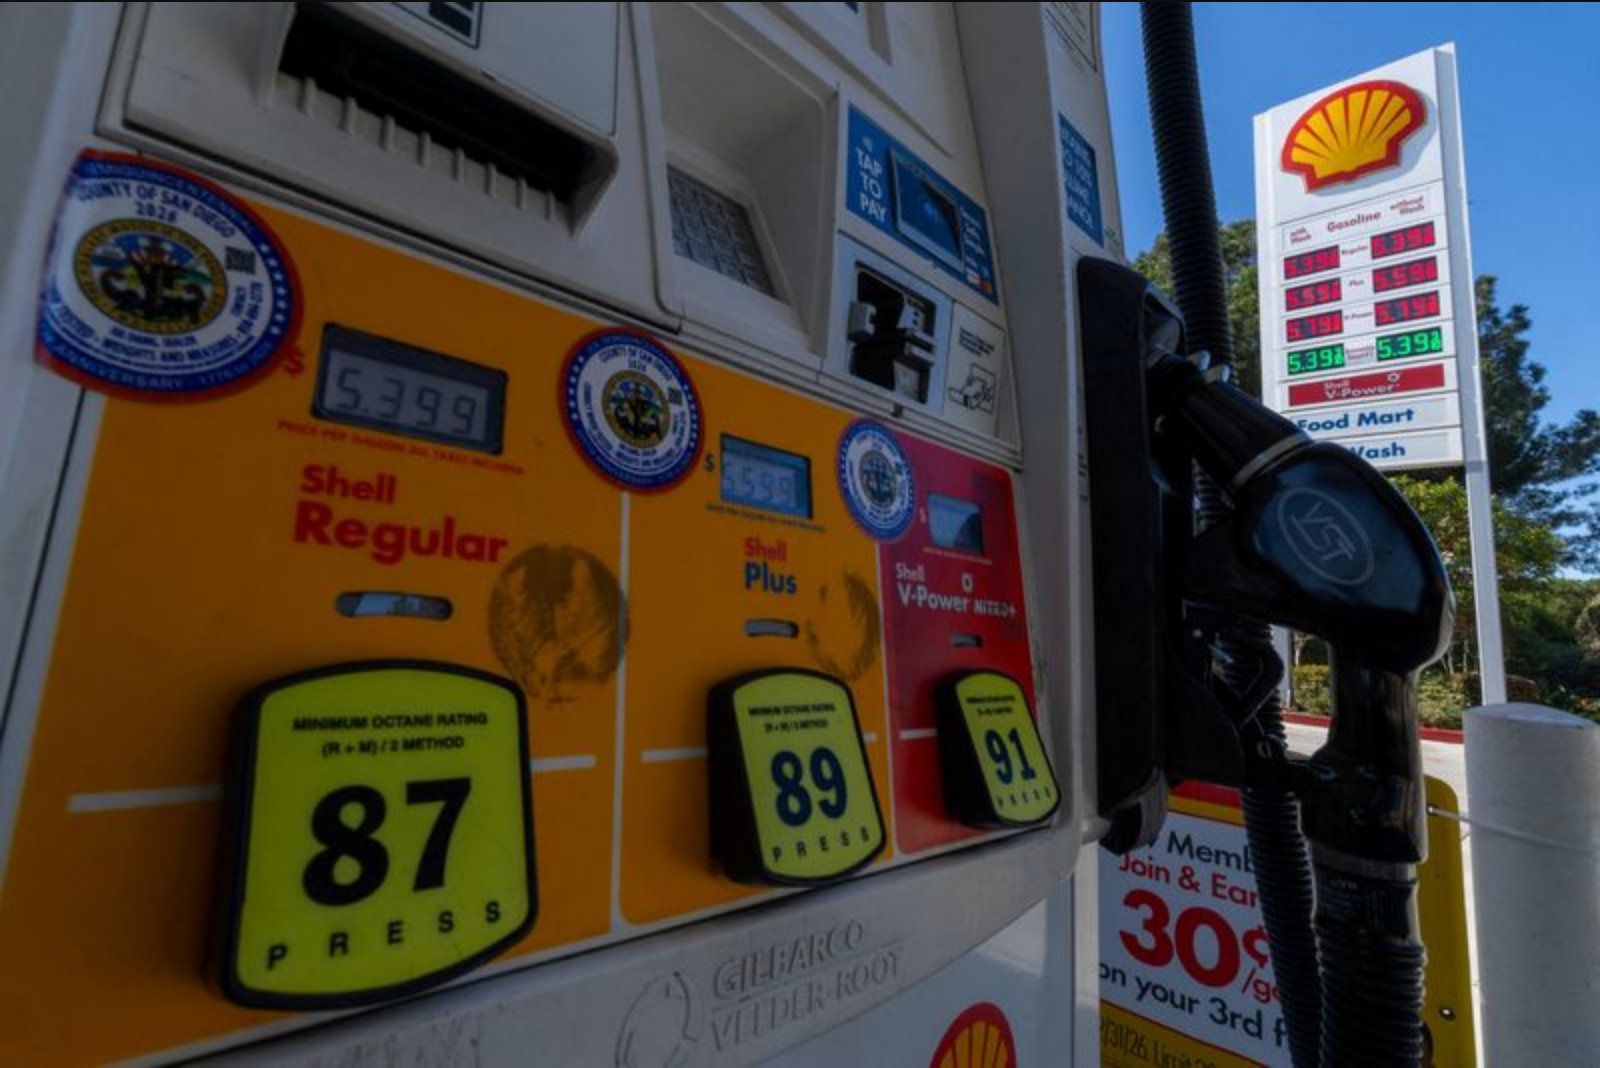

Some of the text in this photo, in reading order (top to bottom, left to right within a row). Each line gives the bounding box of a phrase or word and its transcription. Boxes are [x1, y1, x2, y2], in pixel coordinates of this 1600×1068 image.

[855, 147, 883, 178] TAP
[161, 190, 189, 211] SAN
[861, 174, 882, 199] TO
[859, 192, 886, 224] PAY
[1327, 211, 1381, 232] Gasoline
[335, 365, 477, 435] 5.399
[1325, 384, 1394, 399] V-Power
[1298, 409, 1415, 432] Food Mart
[301, 463, 397, 504] Shell
[294, 500, 507, 565] Regular
[744, 536, 787, 563] Shell
[744, 561, 797, 594] Plus
[895, 562, 925, 583] Shell
[898, 581, 968, 612] V-Power
[293, 711, 488, 732] MINIMUM OCTANE RATING
[322, 740, 340, 760] (R
[359, 738, 378, 757] M)
[389, 738, 399, 752] 2
[402, 735, 464, 751] METHOD
[985, 727, 1036, 784] 91
[771, 746, 847, 826] 89
[303, 776, 471, 907] 87
[1119, 851, 1170, 885] Join
[1178, 865, 1201, 893] &
[267, 899, 501, 972] PRESS
[713, 919, 864, 998] GILBARCO
[1099, 963, 1127, 987] on
[1135, 975, 1200, 1015] your
[1208, 996, 1263, 1041] 3rd
